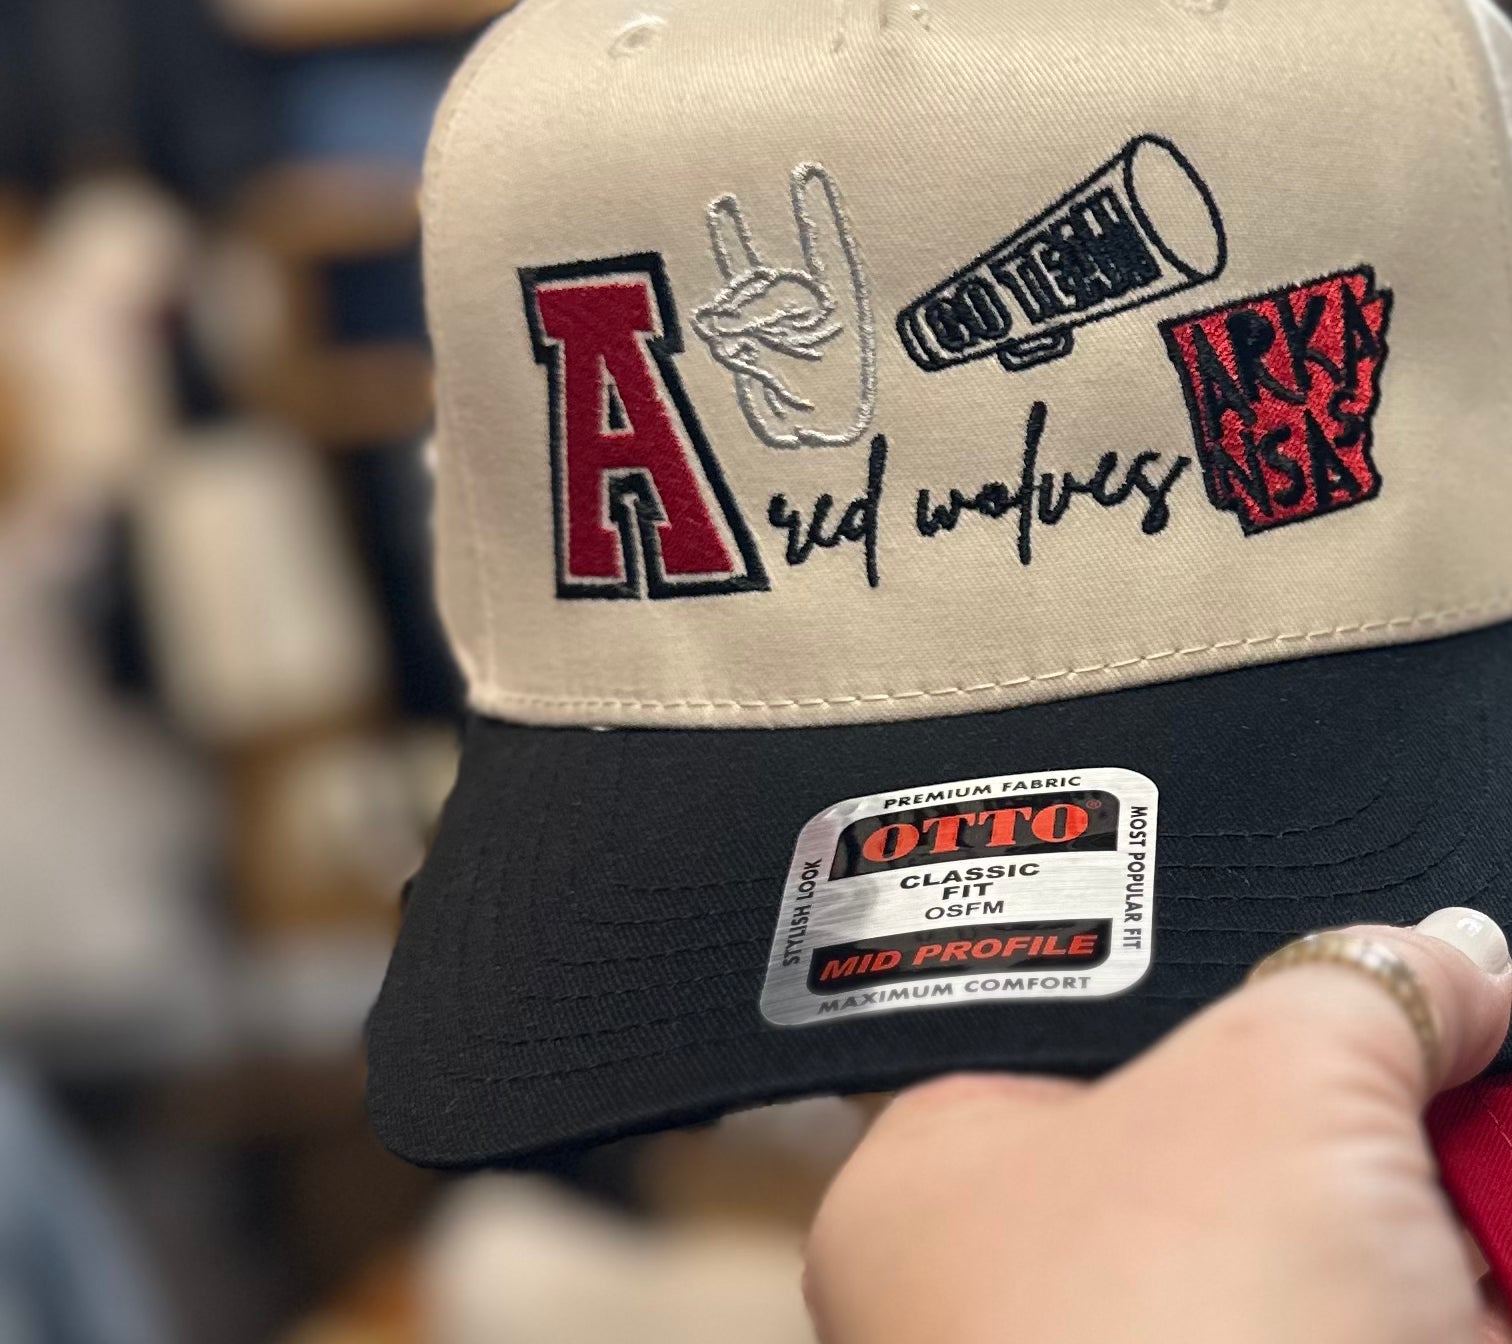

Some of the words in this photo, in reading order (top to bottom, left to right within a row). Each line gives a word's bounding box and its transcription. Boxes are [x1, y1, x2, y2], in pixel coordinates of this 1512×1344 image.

[925, 274, 1013, 351] GO
[516, 251, 772, 599] A
[768, 434, 888, 587] red
[916, 401, 1192, 565] wolves
[883, 783, 992, 810] PREMIUM
[1002, 775, 1082, 793] FABRIC
[862, 803, 1090, 863] OTTO
[1129, 806, 1149, 847] MOST
[797, 857, 822, 901] LOOK
[900, 862, 1041, 890] CLASSIC
[942, 882, 994, 900] FIT
[1123, 852, 1146, 923] POPULAR
[924, 899, 1006, 921] OSFM
[782, 902, 813, 967] STYLISH
[1122, 928, 1142, 950] FIT
[819, 950, 902, 982] MID
[912, 934, 1099, 967] PROFILE
[817, 982, 953, 1015] MAXIMUM
[964, 975, 1092, 994] COMFORT
